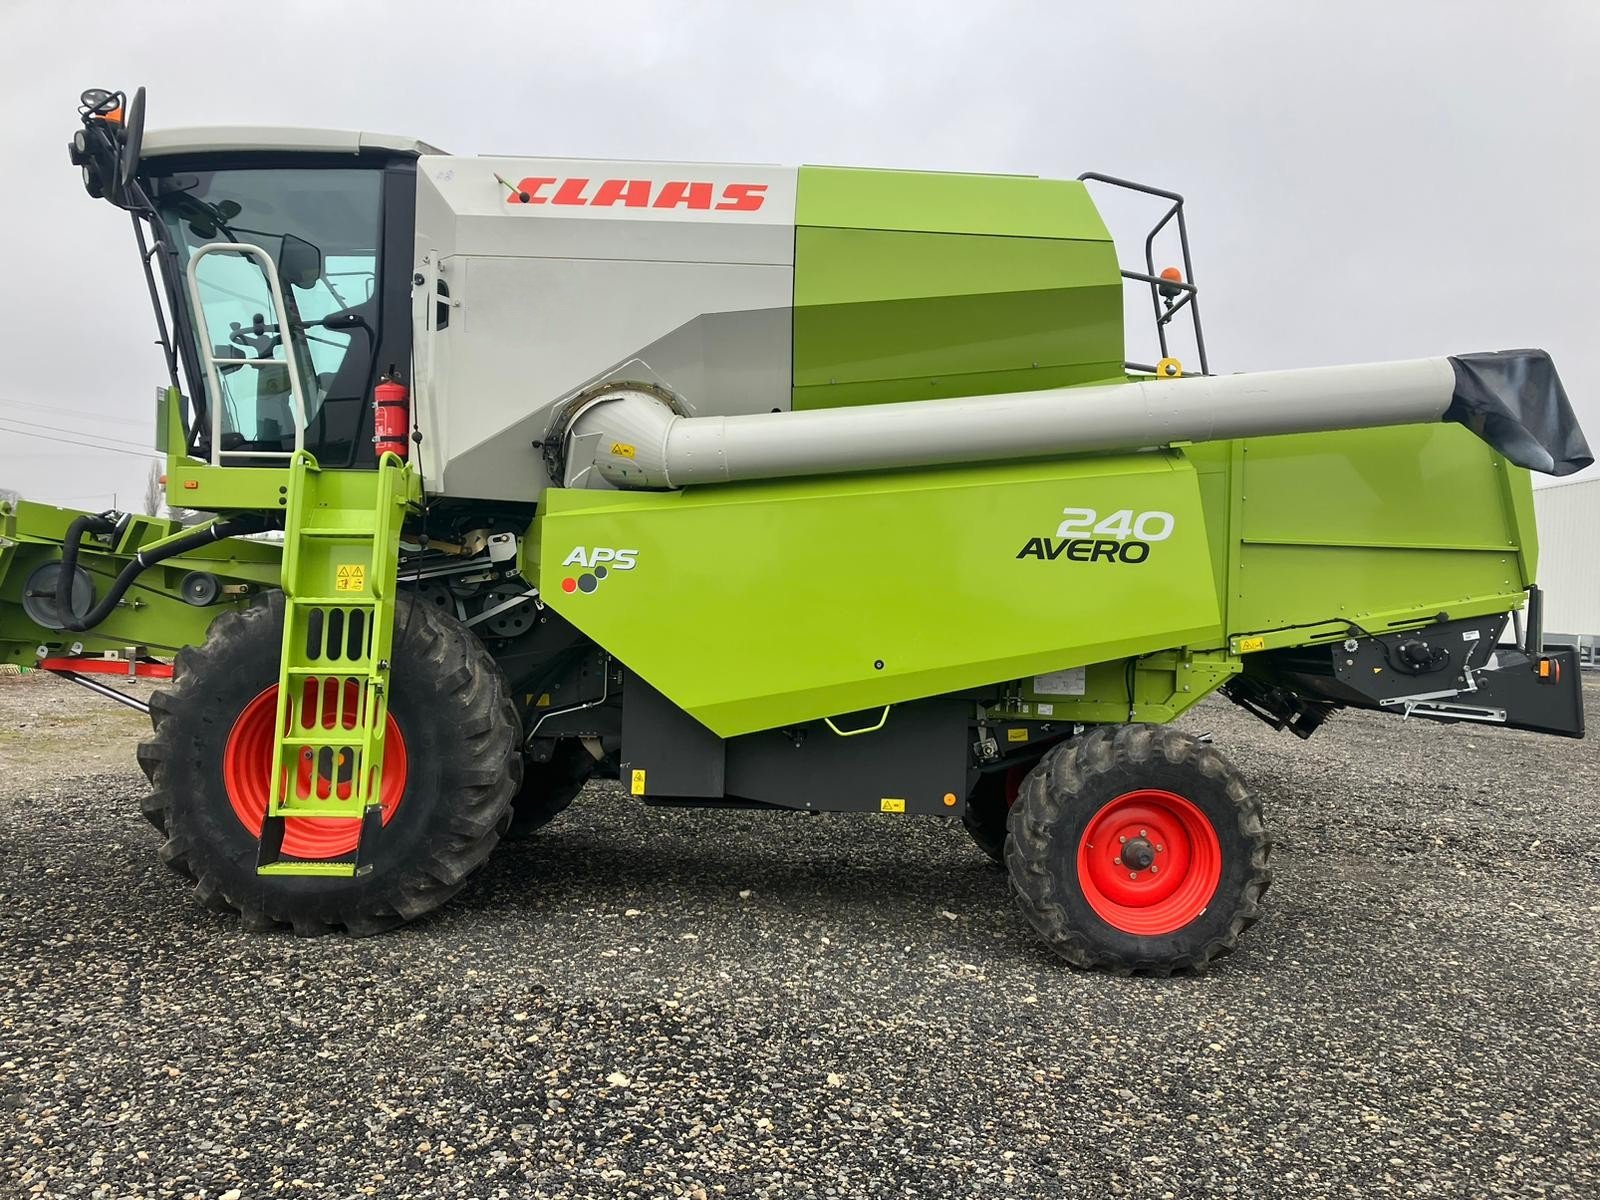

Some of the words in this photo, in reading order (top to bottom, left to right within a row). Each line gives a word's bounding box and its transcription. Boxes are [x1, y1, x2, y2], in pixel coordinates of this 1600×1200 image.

[507, 177, 768, 211] CLAAS
[1056, 507, 1175, 542] 240
[561, 546, 639, 571] APS
[1015, 537, 1150, 564] AVERO
